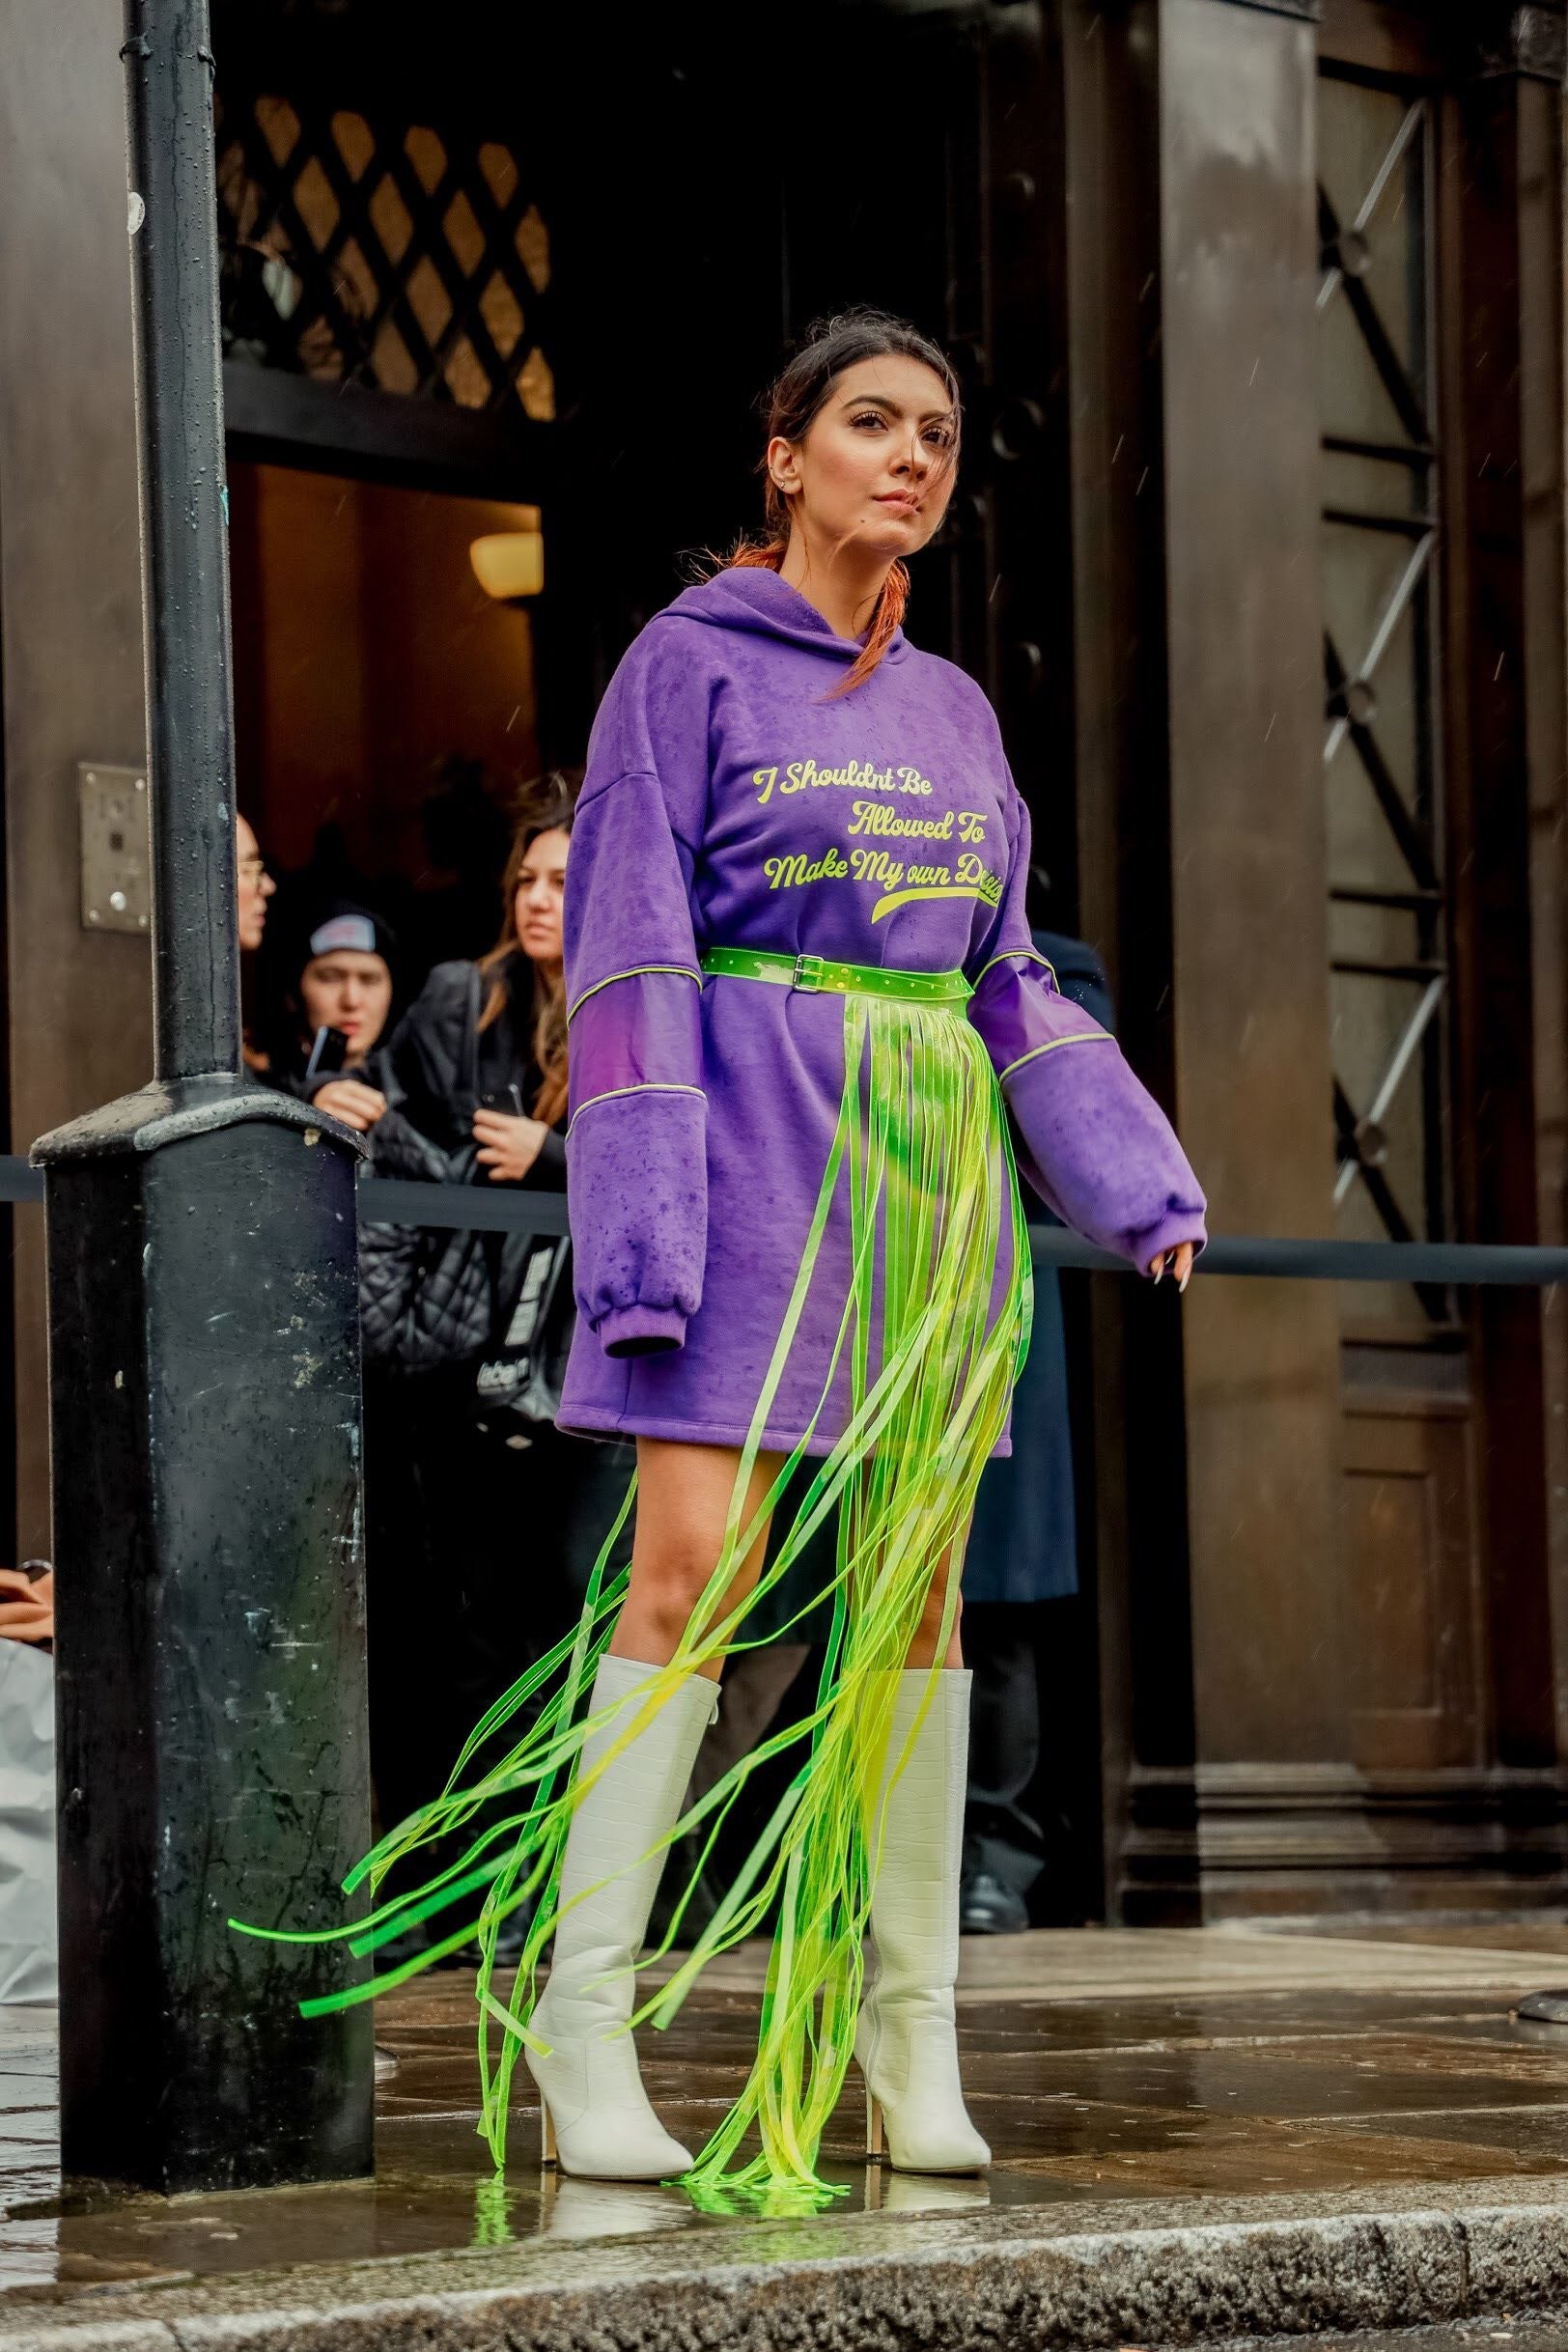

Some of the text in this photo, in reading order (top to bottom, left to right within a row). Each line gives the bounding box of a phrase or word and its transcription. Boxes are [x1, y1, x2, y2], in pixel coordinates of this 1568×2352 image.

[779, 759, 896, 795] Shouldnt
[896, 767, 934, 796] Be
[847, 799, 988, 844] Allowed To
[763, 848, 849, 889] Make
[850, 849, 904, 891] My
[907, 864, 951, 886] own
